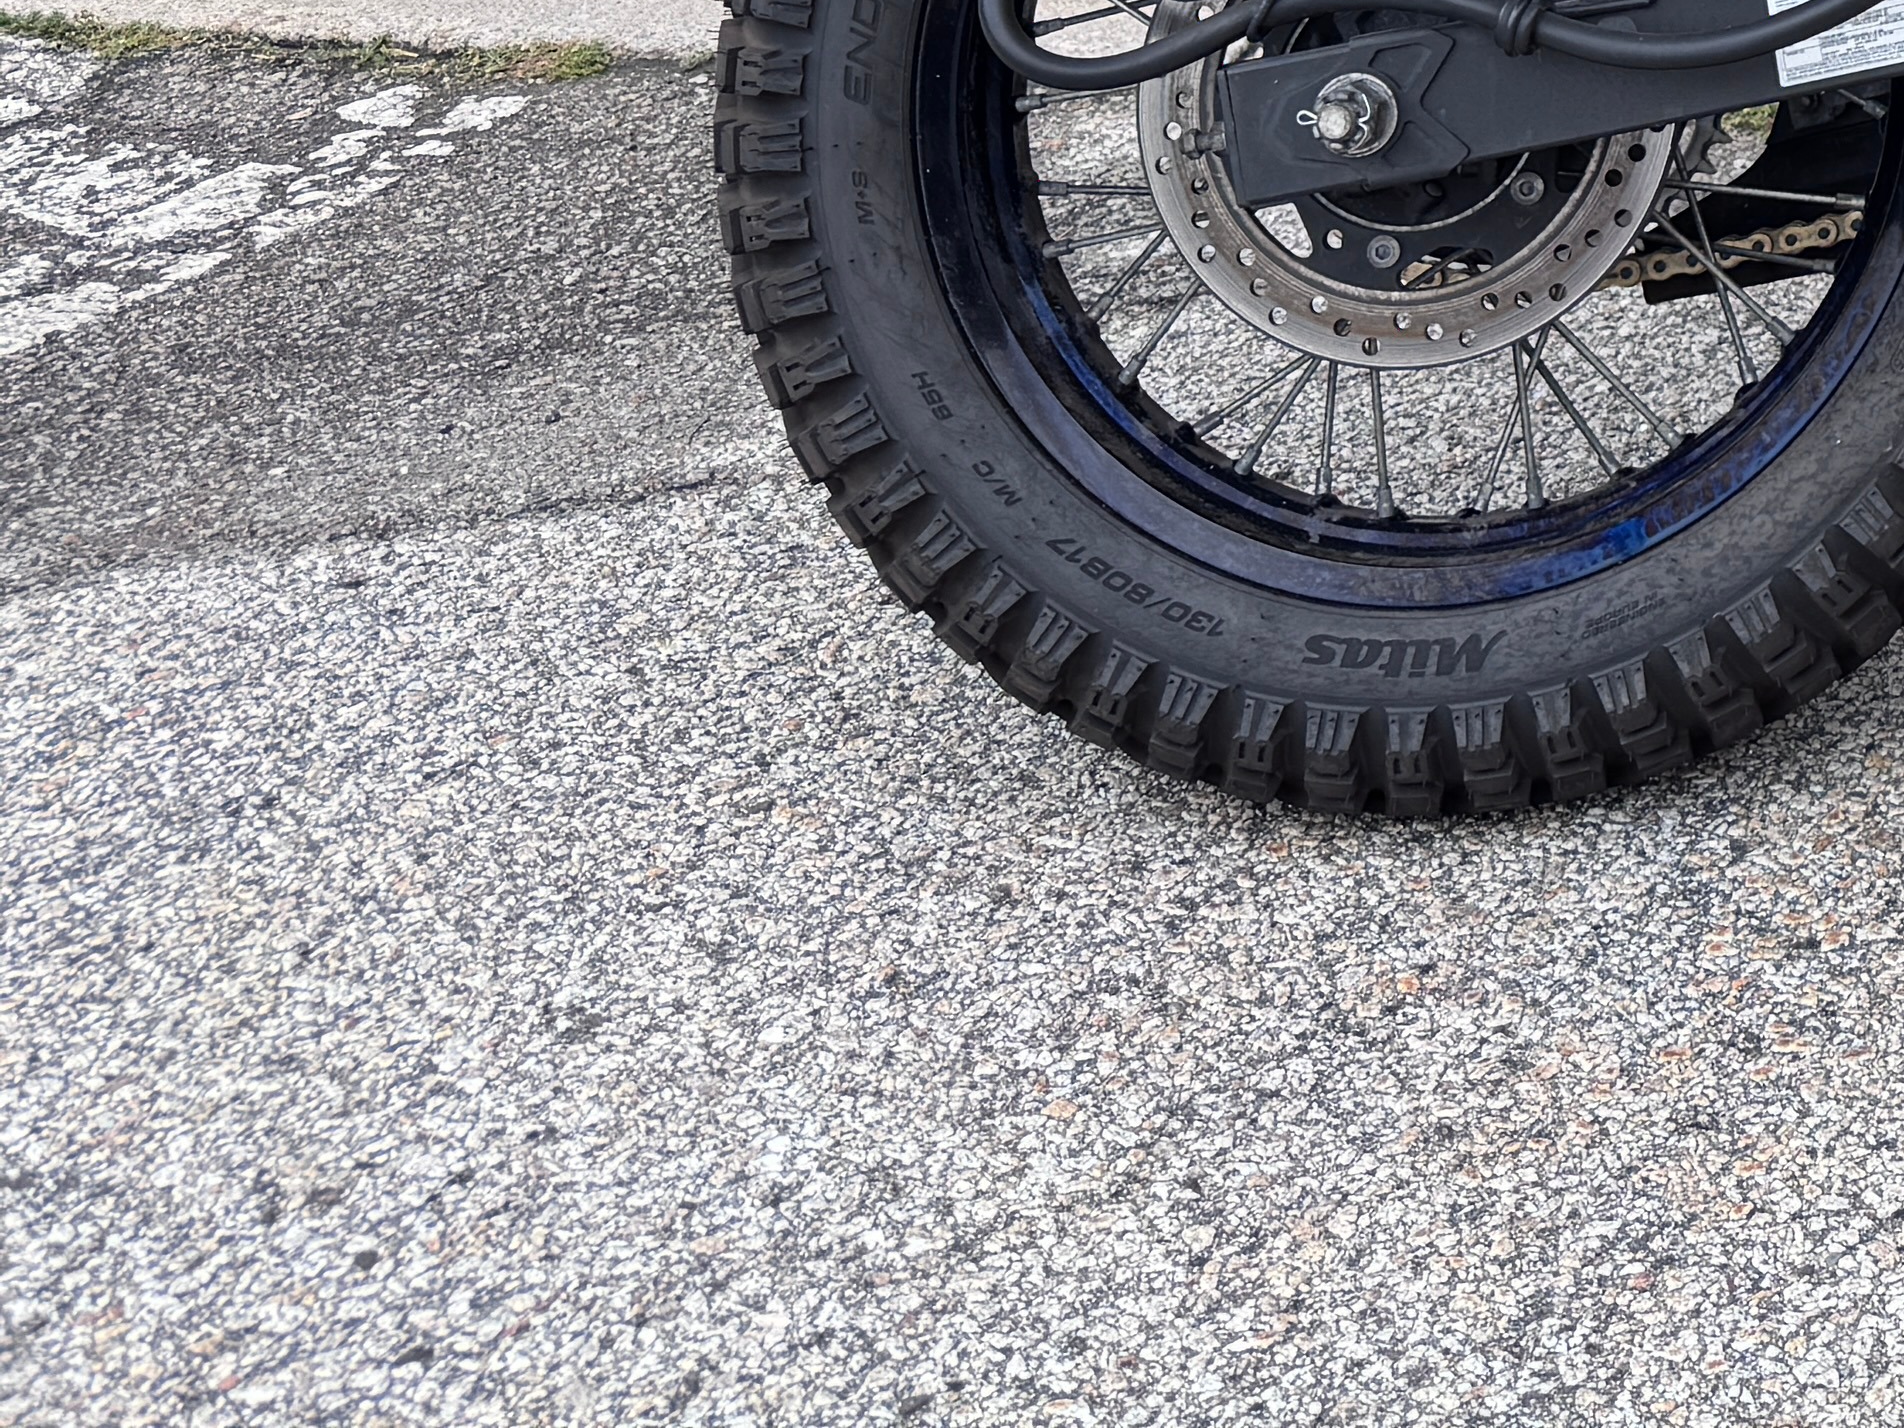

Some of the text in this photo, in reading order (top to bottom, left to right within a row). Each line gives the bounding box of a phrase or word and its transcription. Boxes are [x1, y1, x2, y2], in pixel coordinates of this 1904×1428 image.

[911, 370, 954, 422] 65H
[972, 460, 1021, 508] M/C
[1045, 537, 1226, 640] 130/80B17
[1300, 628, 1509, 681] Mitas
